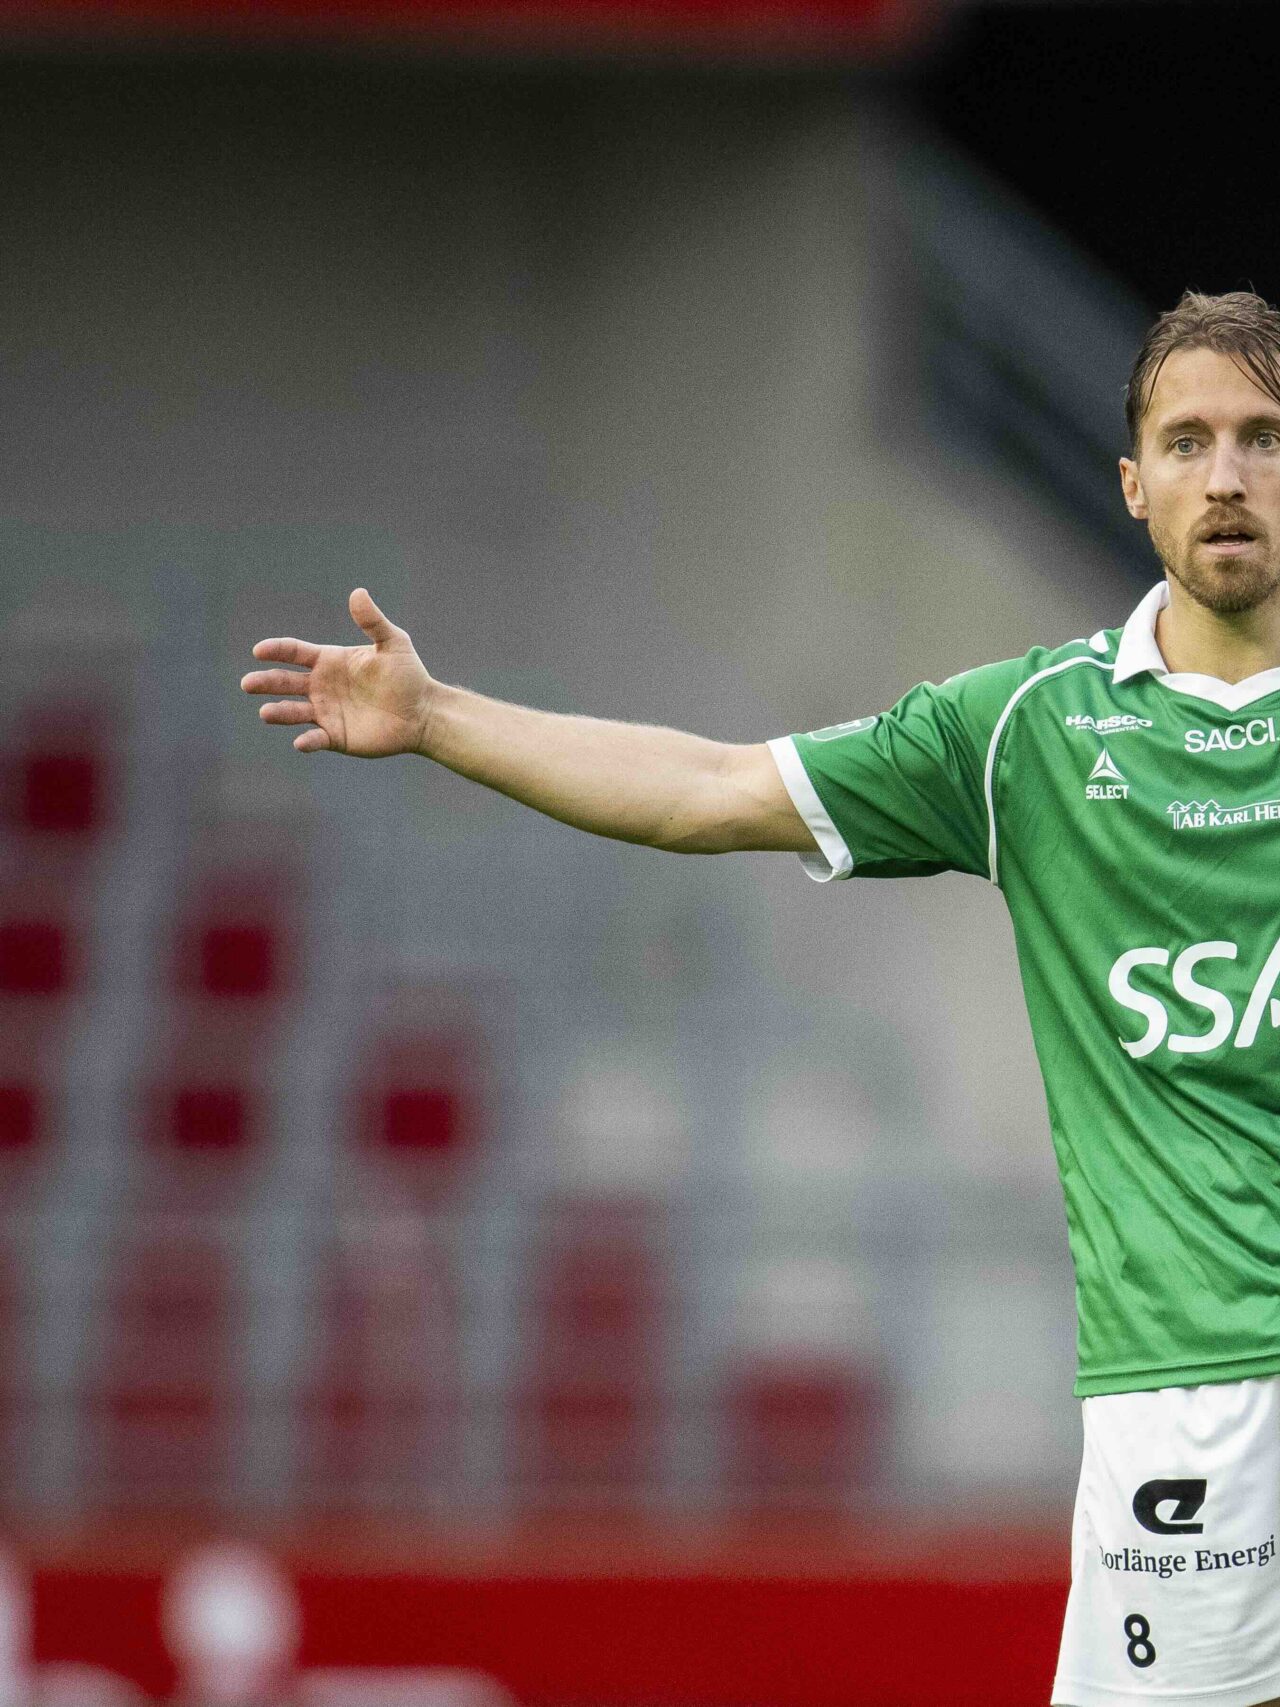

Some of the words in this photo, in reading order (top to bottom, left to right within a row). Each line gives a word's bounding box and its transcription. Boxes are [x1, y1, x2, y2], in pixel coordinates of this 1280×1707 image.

[1085, 784, 1129, 800] SELECT
[1209, 810, 1252, 827] KARL
[1099, 1545, 1187, 1579] orlänge
[1194, 1534, 1276, 1573] Energi
[1124, 1613, 1157, 1668] 8
